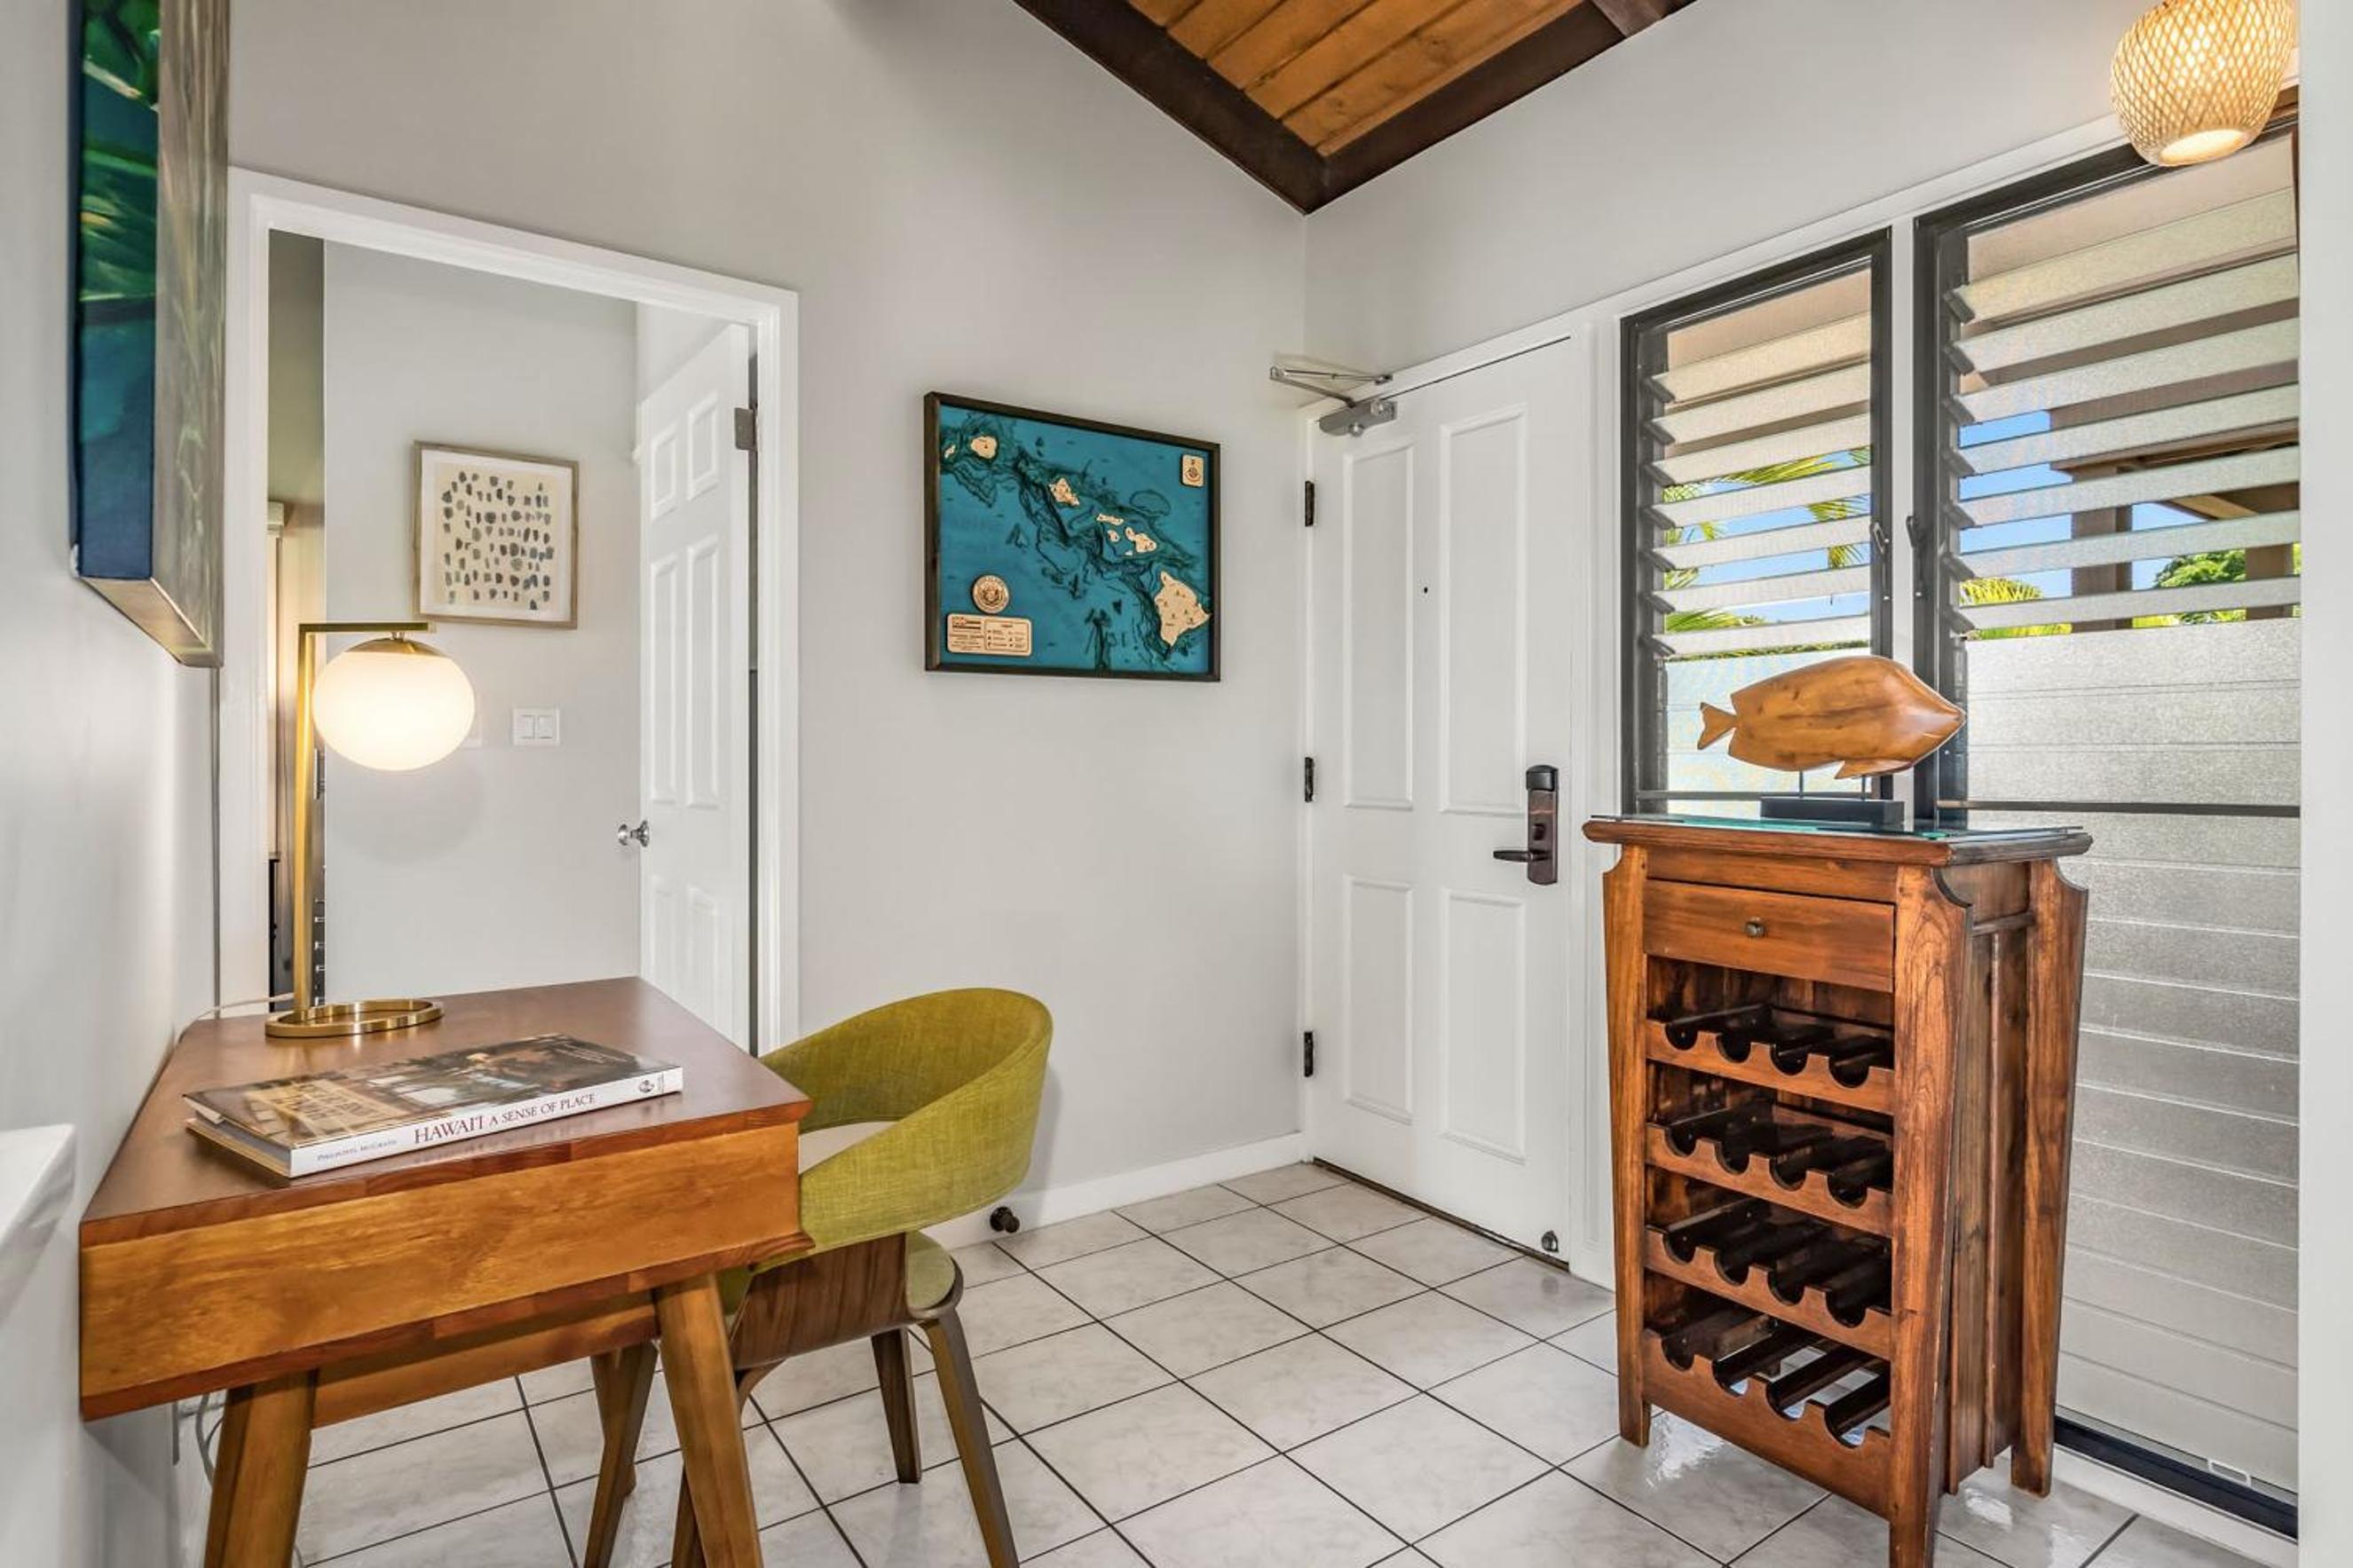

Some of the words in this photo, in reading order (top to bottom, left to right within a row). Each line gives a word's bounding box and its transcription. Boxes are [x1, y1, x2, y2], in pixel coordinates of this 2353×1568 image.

[489, 1115, 499, 1127] A
[501, 1107, 538, 1123] SENSE
[541, 1100, 557, 1115] OF
[560, 1092, 596, 1110] PLACE
